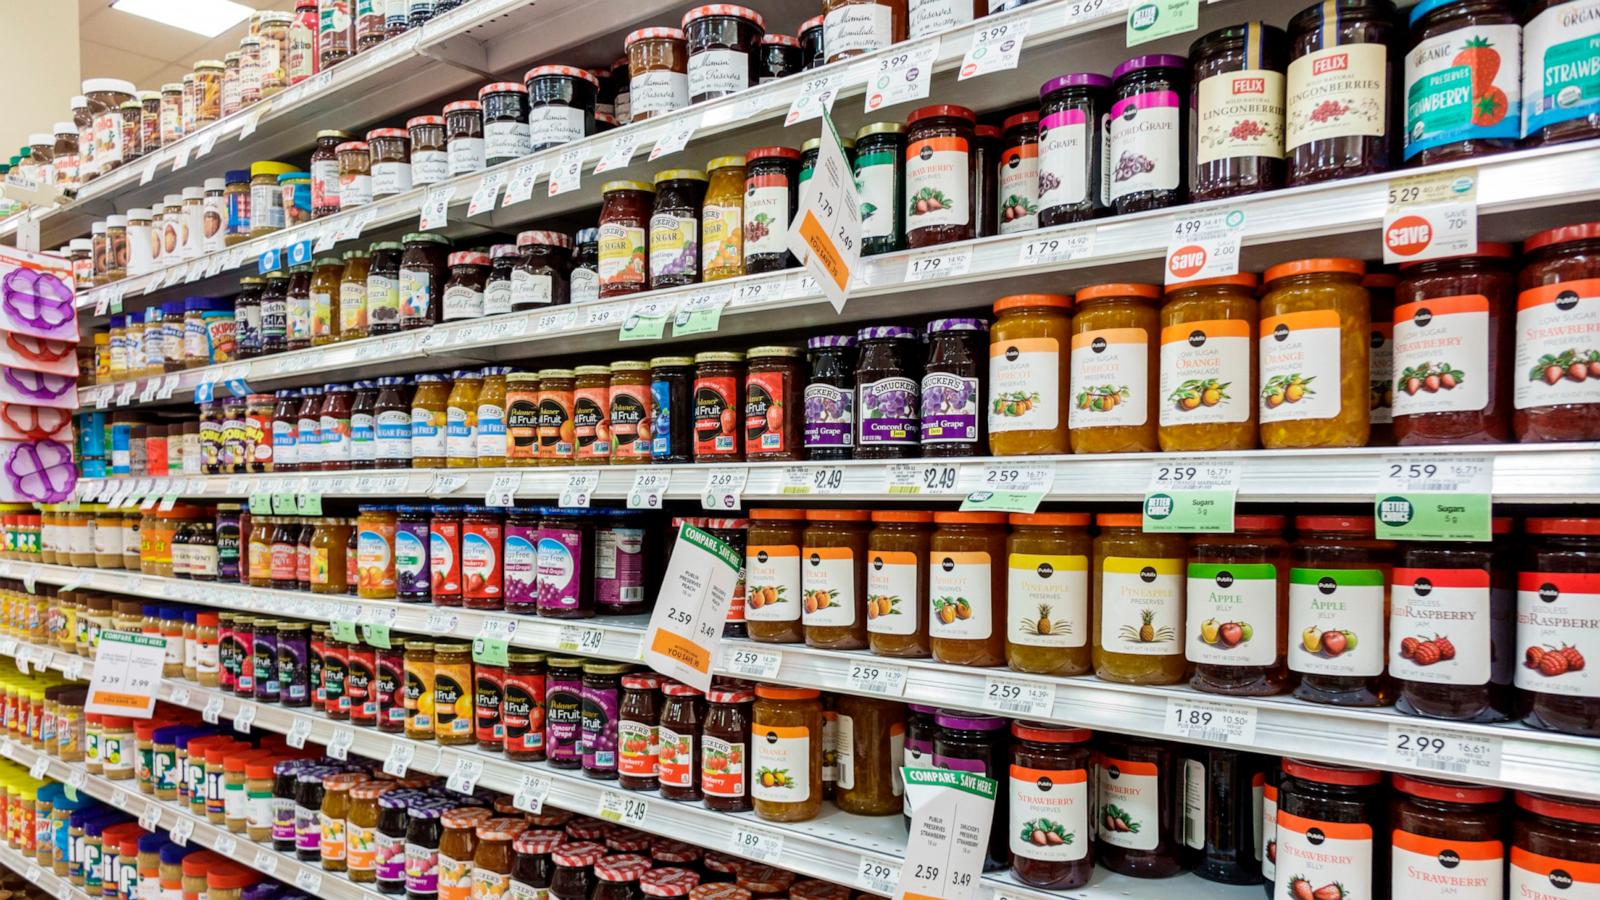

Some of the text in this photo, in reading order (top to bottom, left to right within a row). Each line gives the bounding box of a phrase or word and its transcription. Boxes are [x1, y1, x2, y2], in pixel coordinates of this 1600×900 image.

[1314, 56, 1347, 74] FELIX
[1429, 67, 1469, 86] PRESERVES
[1234, 80, 1263, 92] FELIX
[1389, 224, 1429, 246] save
[1172, 250, 1204, 270] save
[263, 316, 284, 326] CHIA
[1176, 357, 1221, 369] ORANGE
[700, 405, 720, 414] Fruit
[749, 404, 767, 413] Fruit
[518, 416, 538, 424] Fruit
[544, 415, 562, 424] Fruit
[580, 414, 597, 423] Fruit
[618, 411, 639, 420] Fruit
[871, 423, 902, 431] Concord
[941, 420, 964, 428] Grape
[814, 470, 842, 488] $2.49
[924, 468, 956, 489] $2.49
[1158, 467, 1197, 480] 2.59
[1437, 505, 1465, 513] Sugars
[684, 526, 718, 552] COMPARE.
[1209, 592, 1243, 604] APPLE
[1311, 599, 1345, 610] APPLE
[667, 607, 692, 625] 2.59
[1405, 607, 1476, 620] RASPBERRY
[700, 622, 715, 638] 3.49
[582, 630, 602, 649] $2.49
[439, 691, 457, 700] Fruit
[989, 684, 1020, 699] 2.59
[479, 695, 499, 704] Fruit
[510, 702, 529, 713] Fruit
[558, 710, 580, 720] Fruit
[1176, 709, 1212, 725] 1.89
[583, 718, 601, 728] Fruit
[1398, 734, 1445, 753] 2.99
[909, 770, 993, 794] COMPARE. SAVE HERE.
[1018, 792, 1073, 806] STRAWBERRY
[625, 802, 645, 821] $2.49
[924, 823, 945, 833] PRESERVES
[920, 830, 946, 840] STRAWBERRY
[1283, 843, 1352, 864] STRAWBERRY
[915, 864, 971, 886] 2.59 3.49
[1408, 866, 1488, 887] STRAWBERRY
